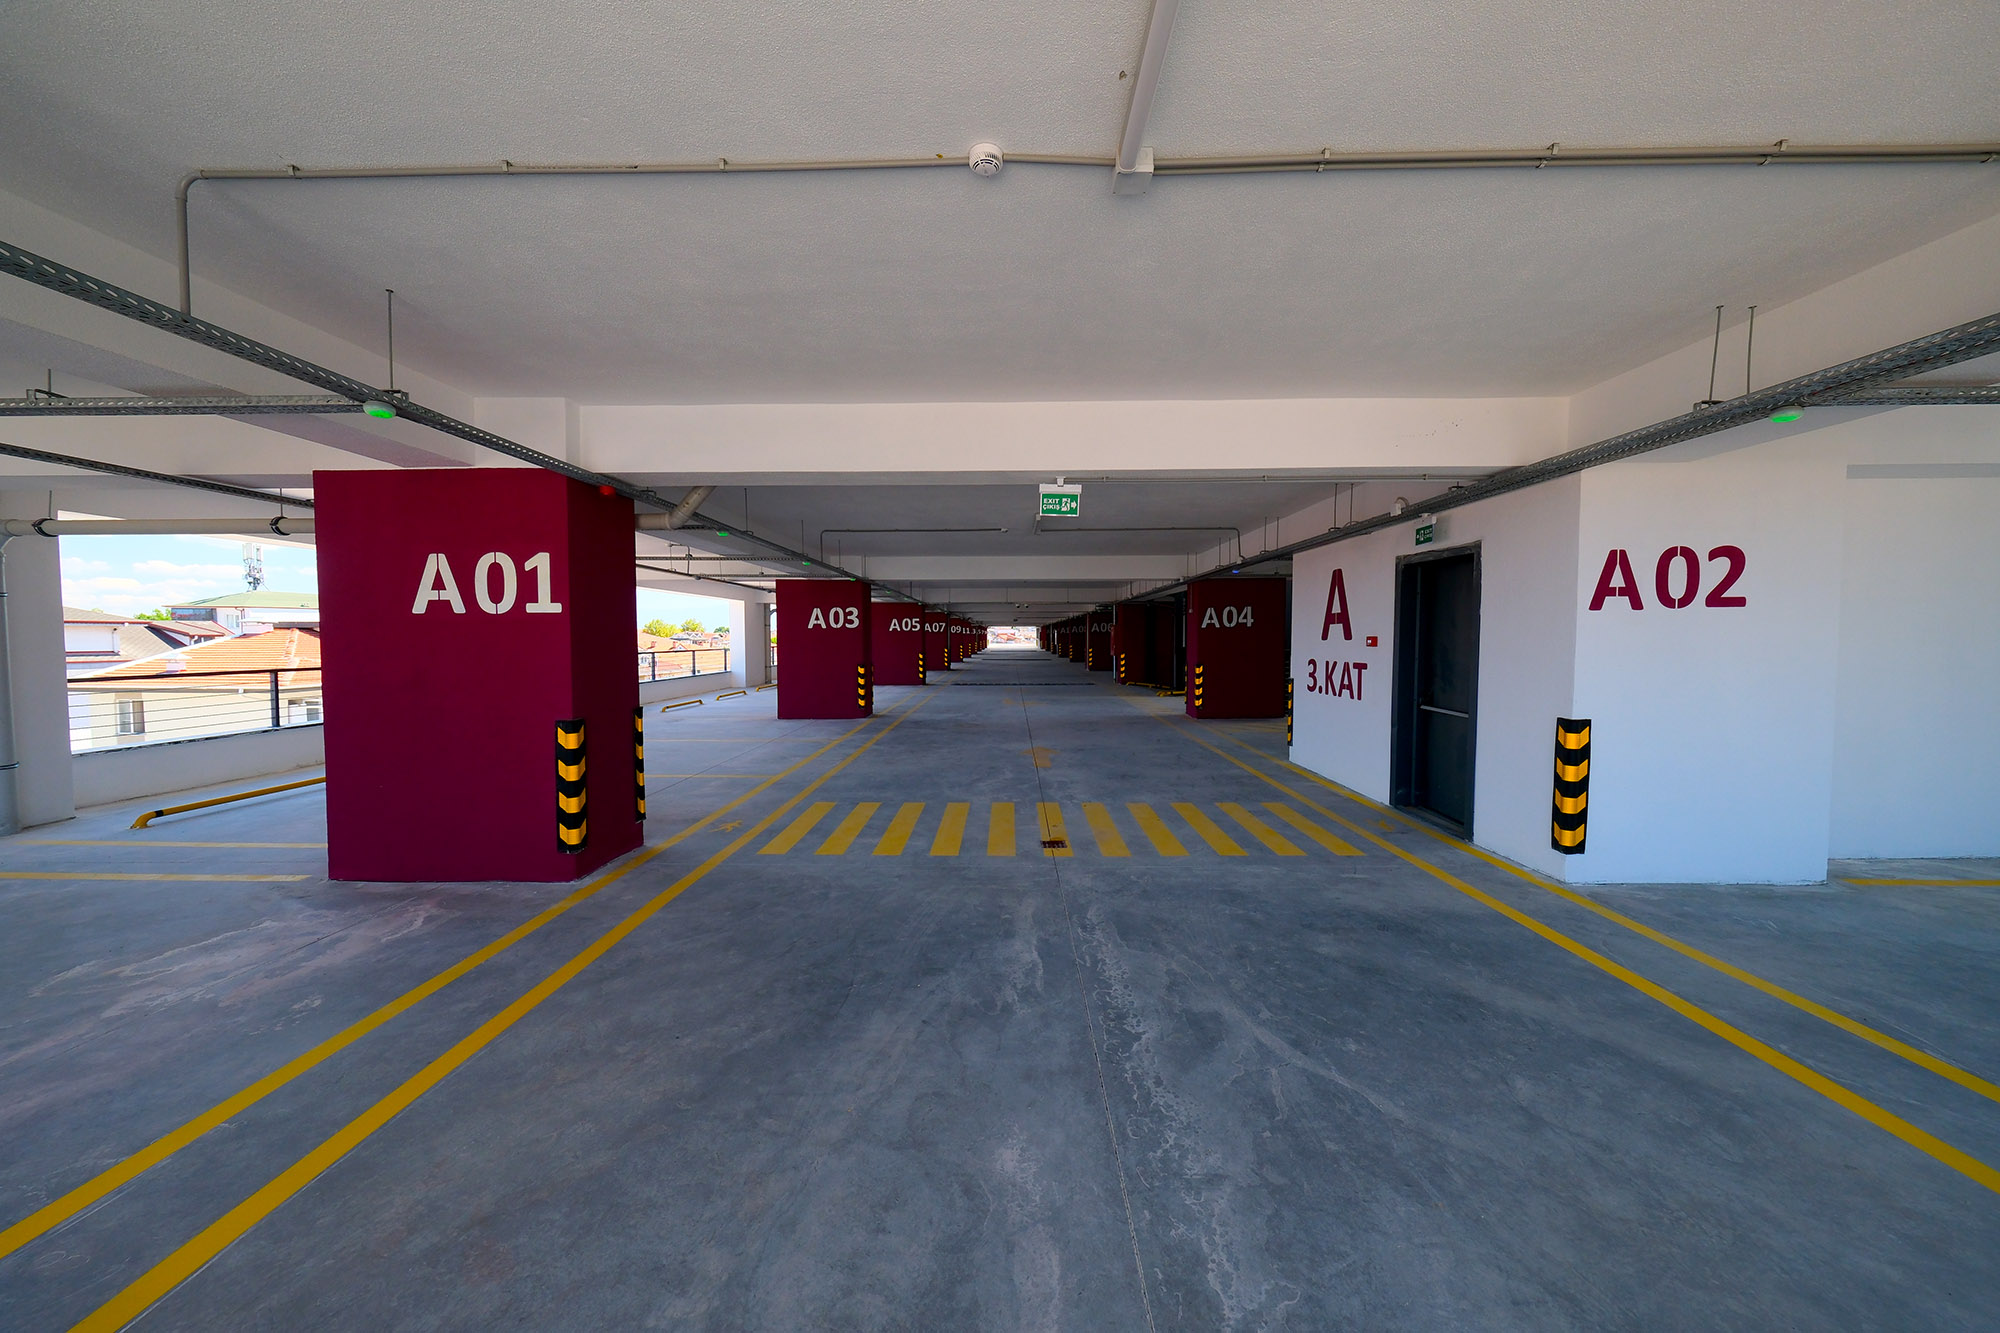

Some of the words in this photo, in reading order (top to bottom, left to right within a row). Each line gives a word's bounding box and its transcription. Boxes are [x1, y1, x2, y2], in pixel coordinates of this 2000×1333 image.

[412, 551, 563, 615] A01
[1588, 545, 1747, 611] A02
[808, 606, 860, 629] A03
[1201, 606, 1254, 628] A04
[1321, 568, 1353, 641] A
[889, 618, 921, 632] A05
[925, 622, 946, 632] A07
[1306, 658, 1368, 701] 3.KAT
